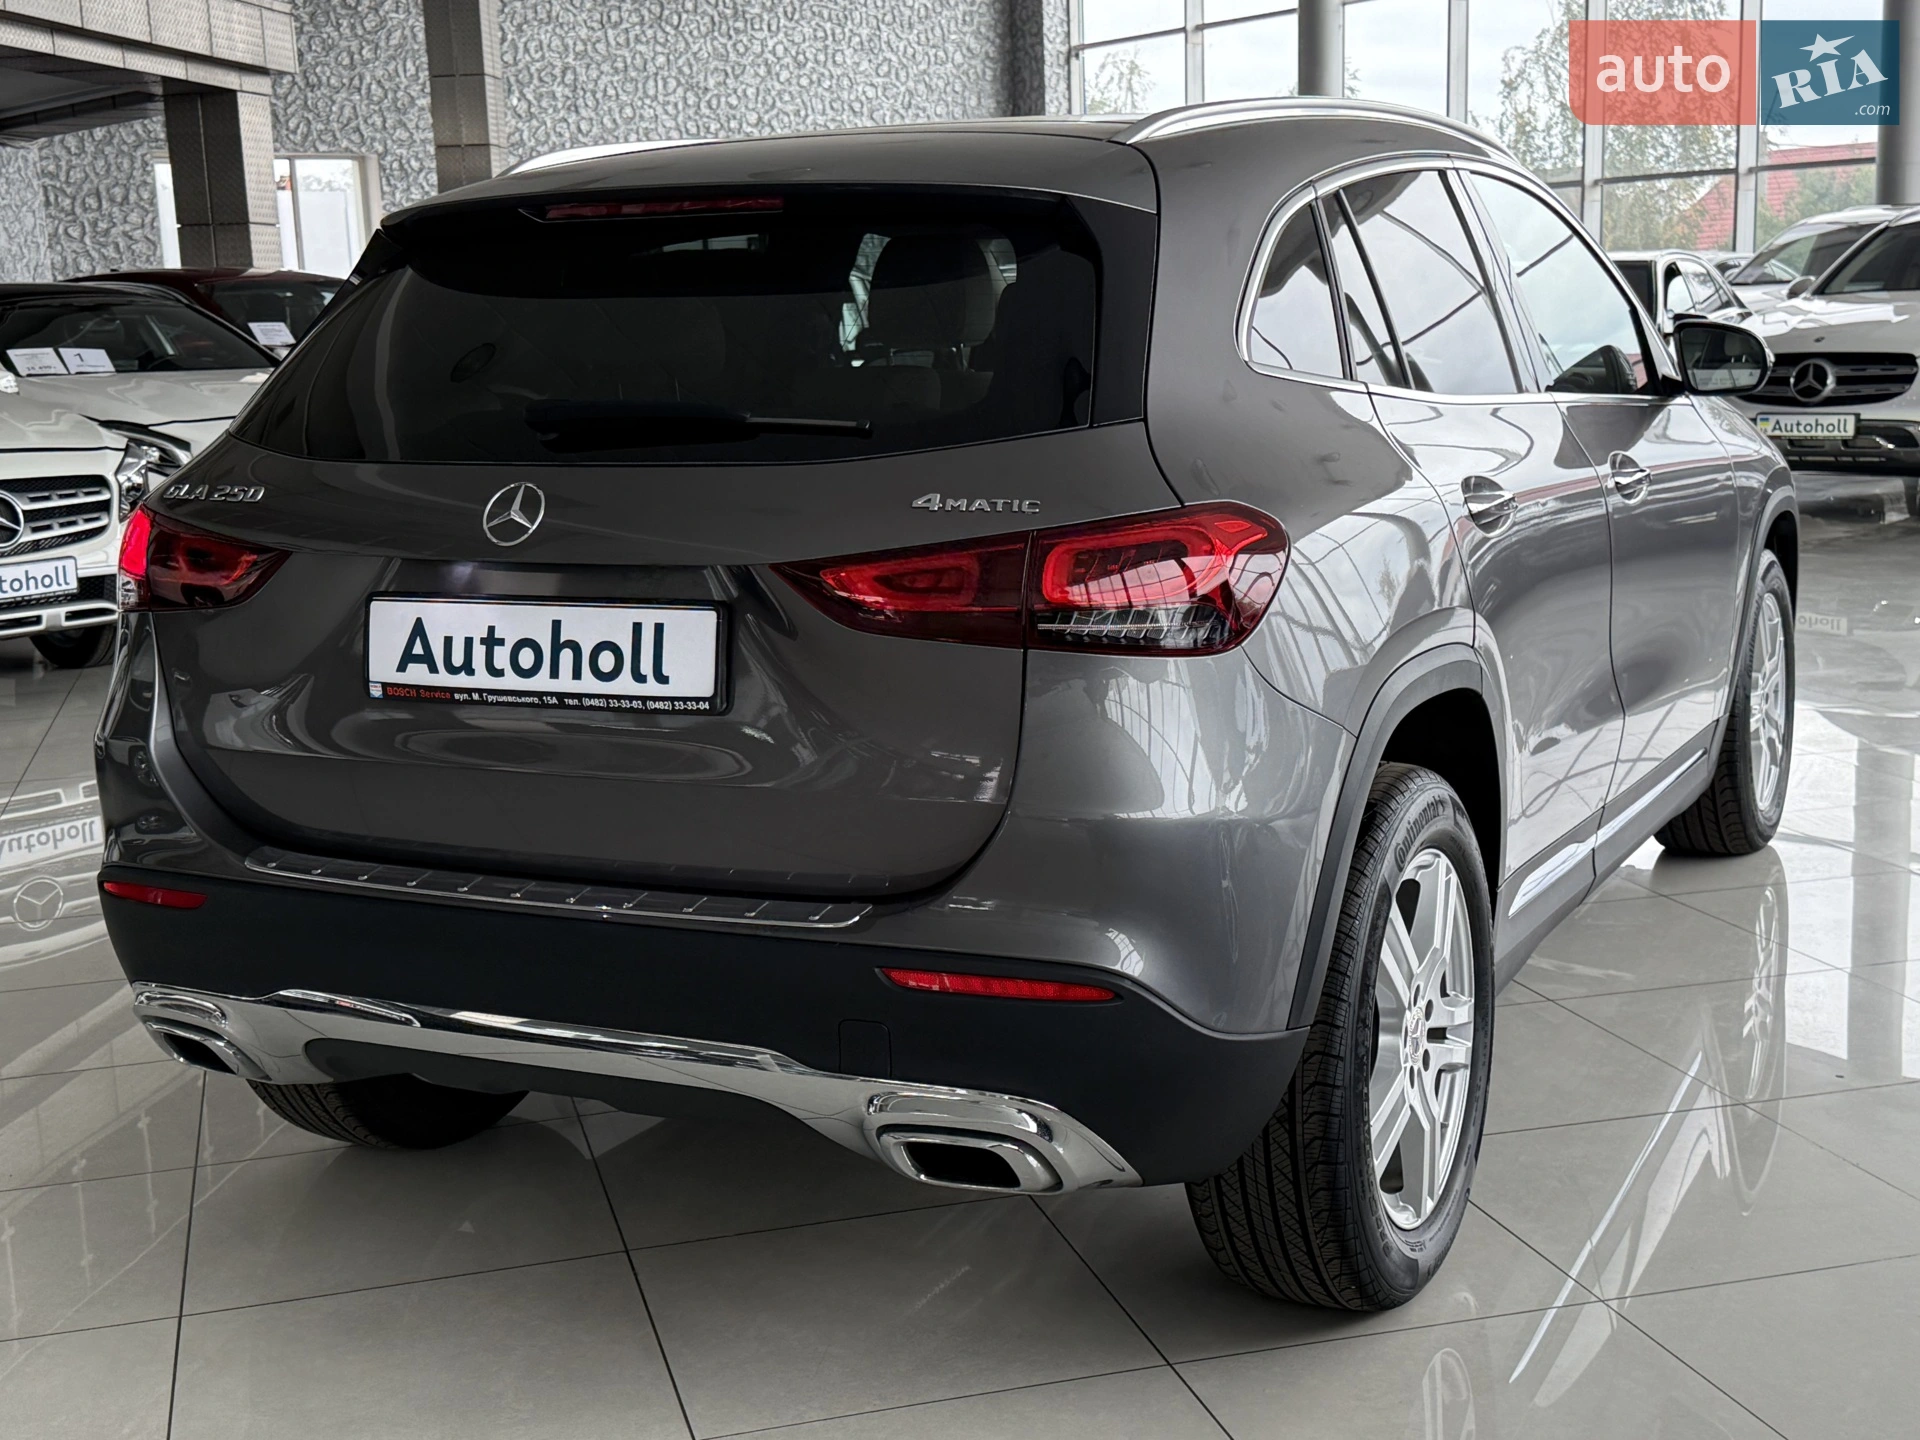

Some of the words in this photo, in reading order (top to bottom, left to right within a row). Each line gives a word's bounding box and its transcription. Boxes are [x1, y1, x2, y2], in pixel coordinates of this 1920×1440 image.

[1771, 418, 1848, 434] Autoholl
[163, 483, 209, 500] GLA
[209, 485, 265, 502] 250
[911, 492, 1041, 513] 4MATIC
[395, 616, 670, 686] Autoholl
[386, 687, 417, 698] BOSCH
[420, 689, 451, 699] Service
[454, 692, 471, 702] вул.
[564, 698, 581, 706] тел.
[582, 697, 607, 708] (0482)
[608, 699, 645, 710] 33-33-03,
[647, 699, 672, 711] (0482)
[674, 701, 710, 711] 33-33-04
[1394, 796, 1441, 873] Continental
